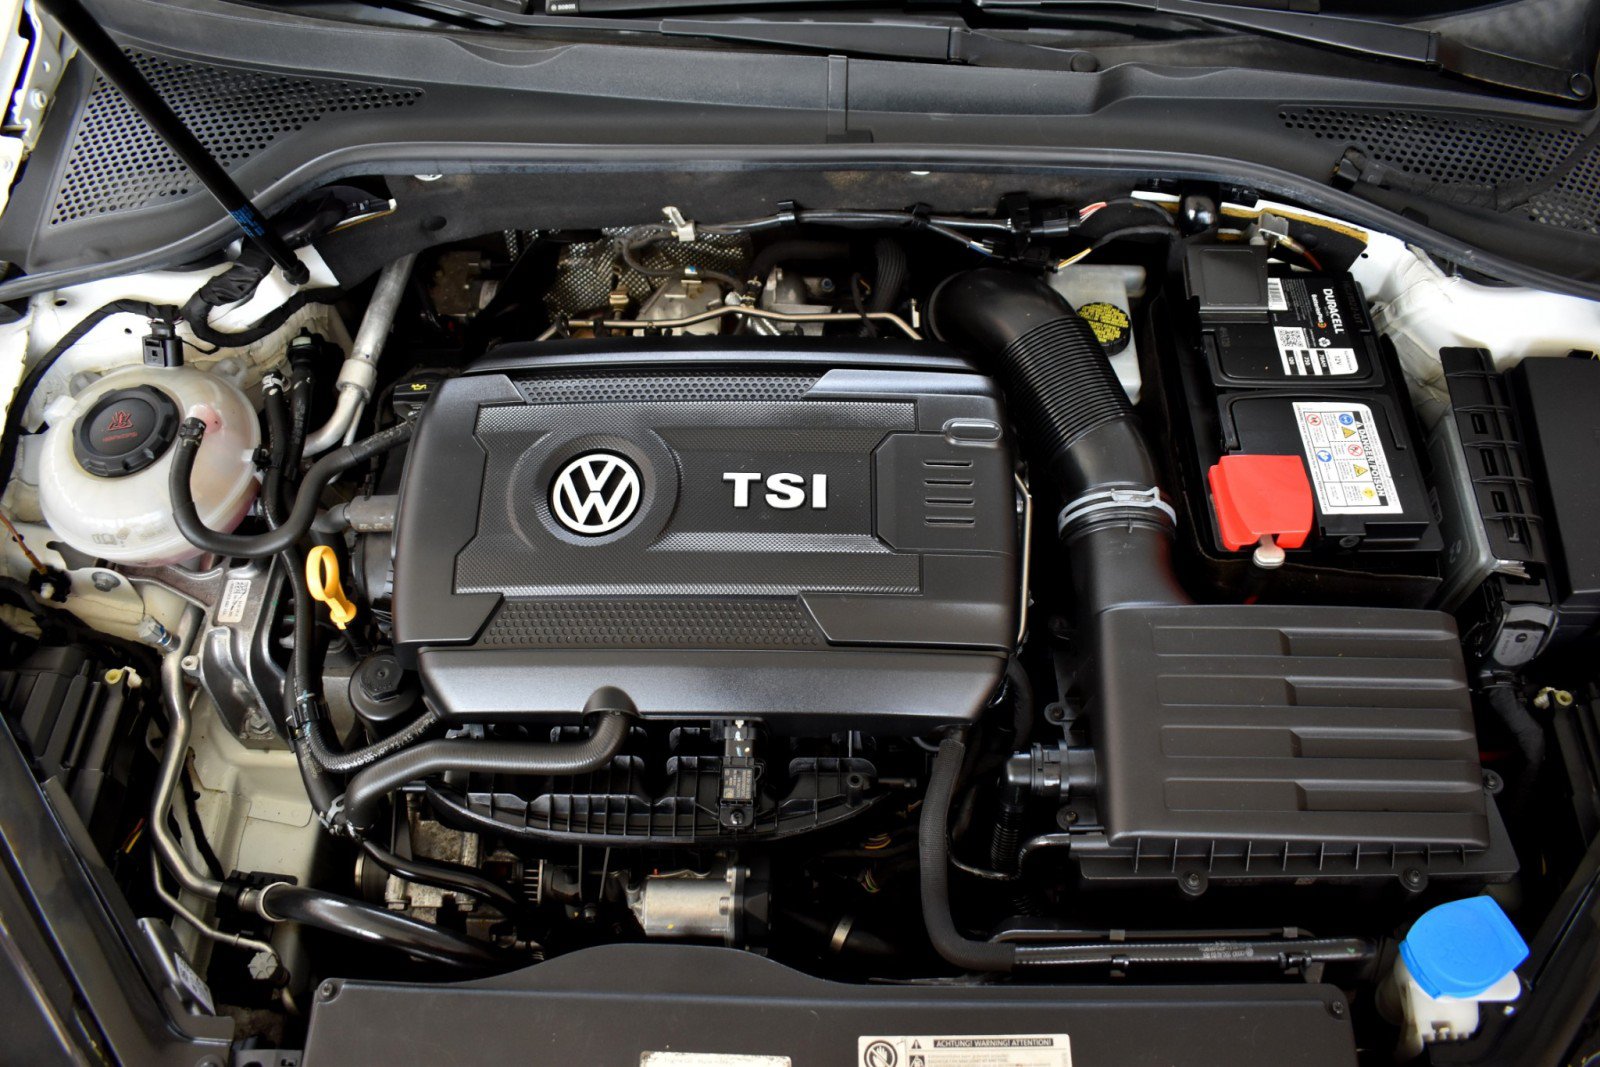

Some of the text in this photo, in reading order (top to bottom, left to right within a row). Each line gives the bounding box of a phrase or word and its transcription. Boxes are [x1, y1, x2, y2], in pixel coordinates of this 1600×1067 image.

[1323, 288, 1345, 335] DURACELL
[722, 472, 827, 509] TSI
[935, 1038, 1052, 1048] ACHTUNG! WARNING! ATTENTION!
